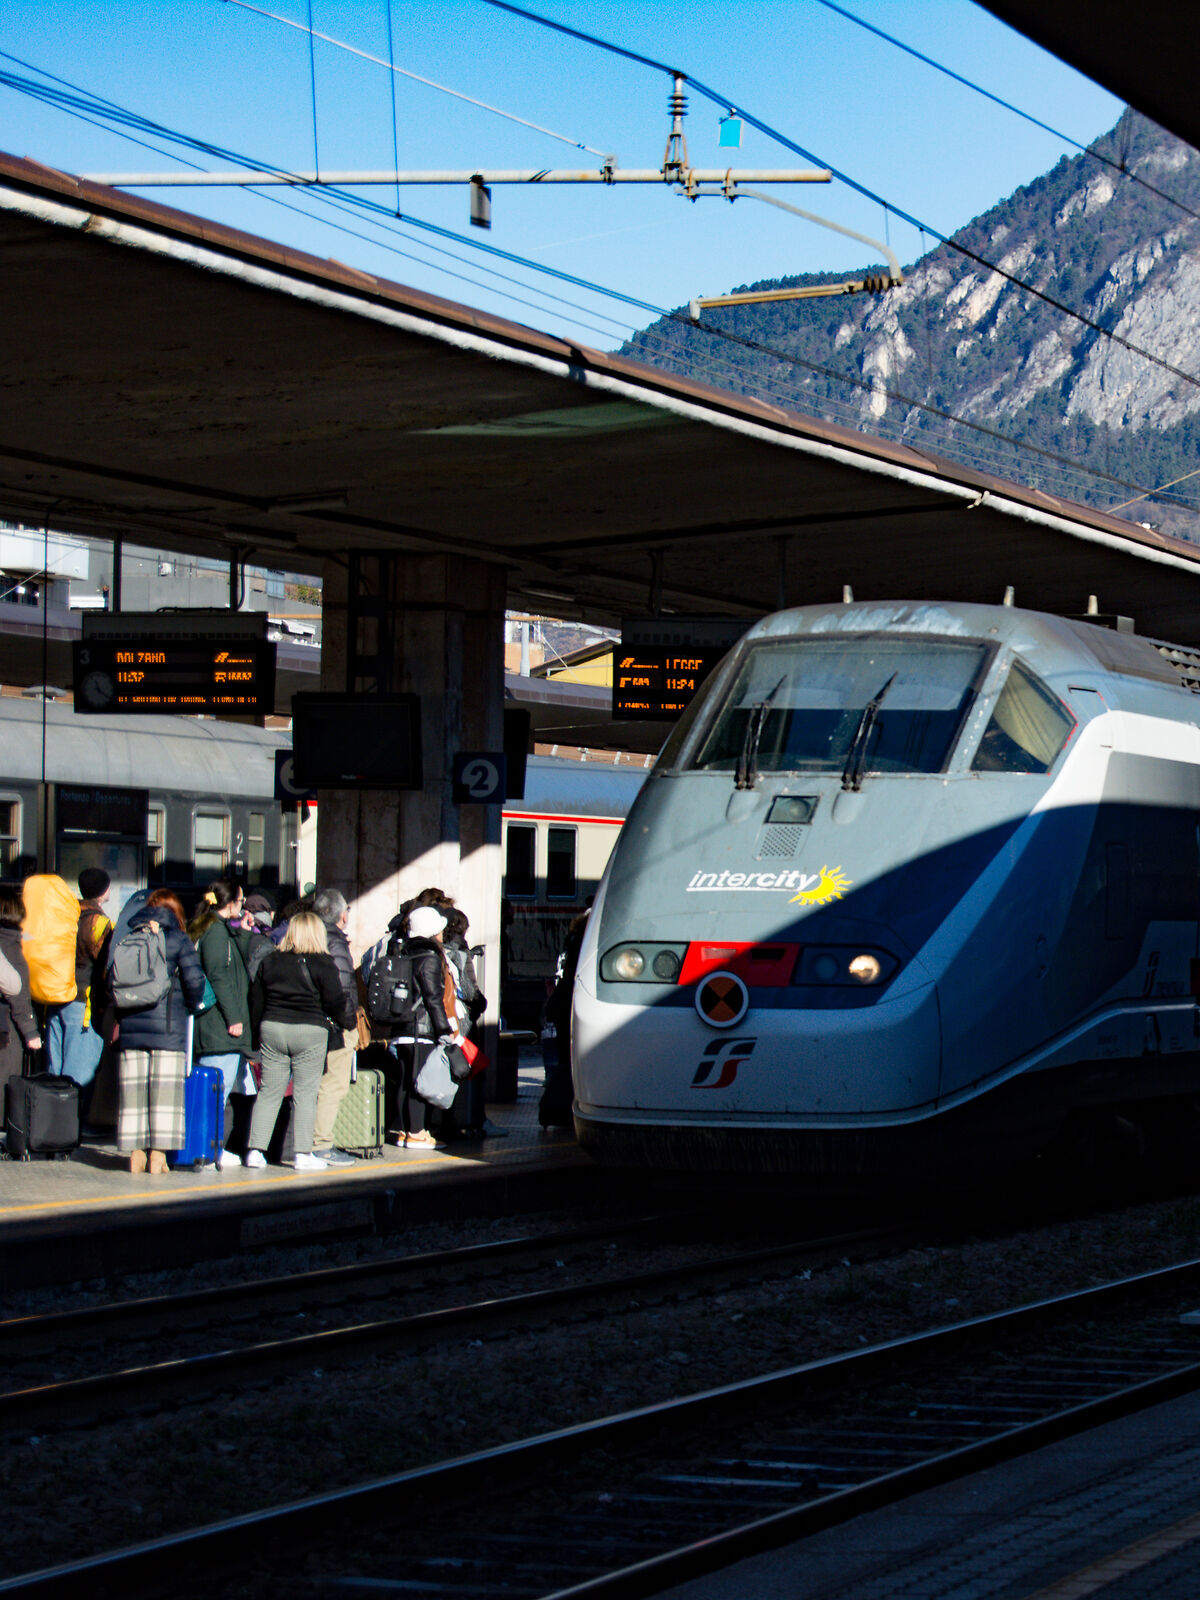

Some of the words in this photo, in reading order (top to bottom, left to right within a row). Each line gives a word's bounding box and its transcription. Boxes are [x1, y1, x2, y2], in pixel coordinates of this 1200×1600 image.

[470, 765, 489, 790] 2
[235, 831, 244, 855] 2
[687, 870, 820, 891] intercity
